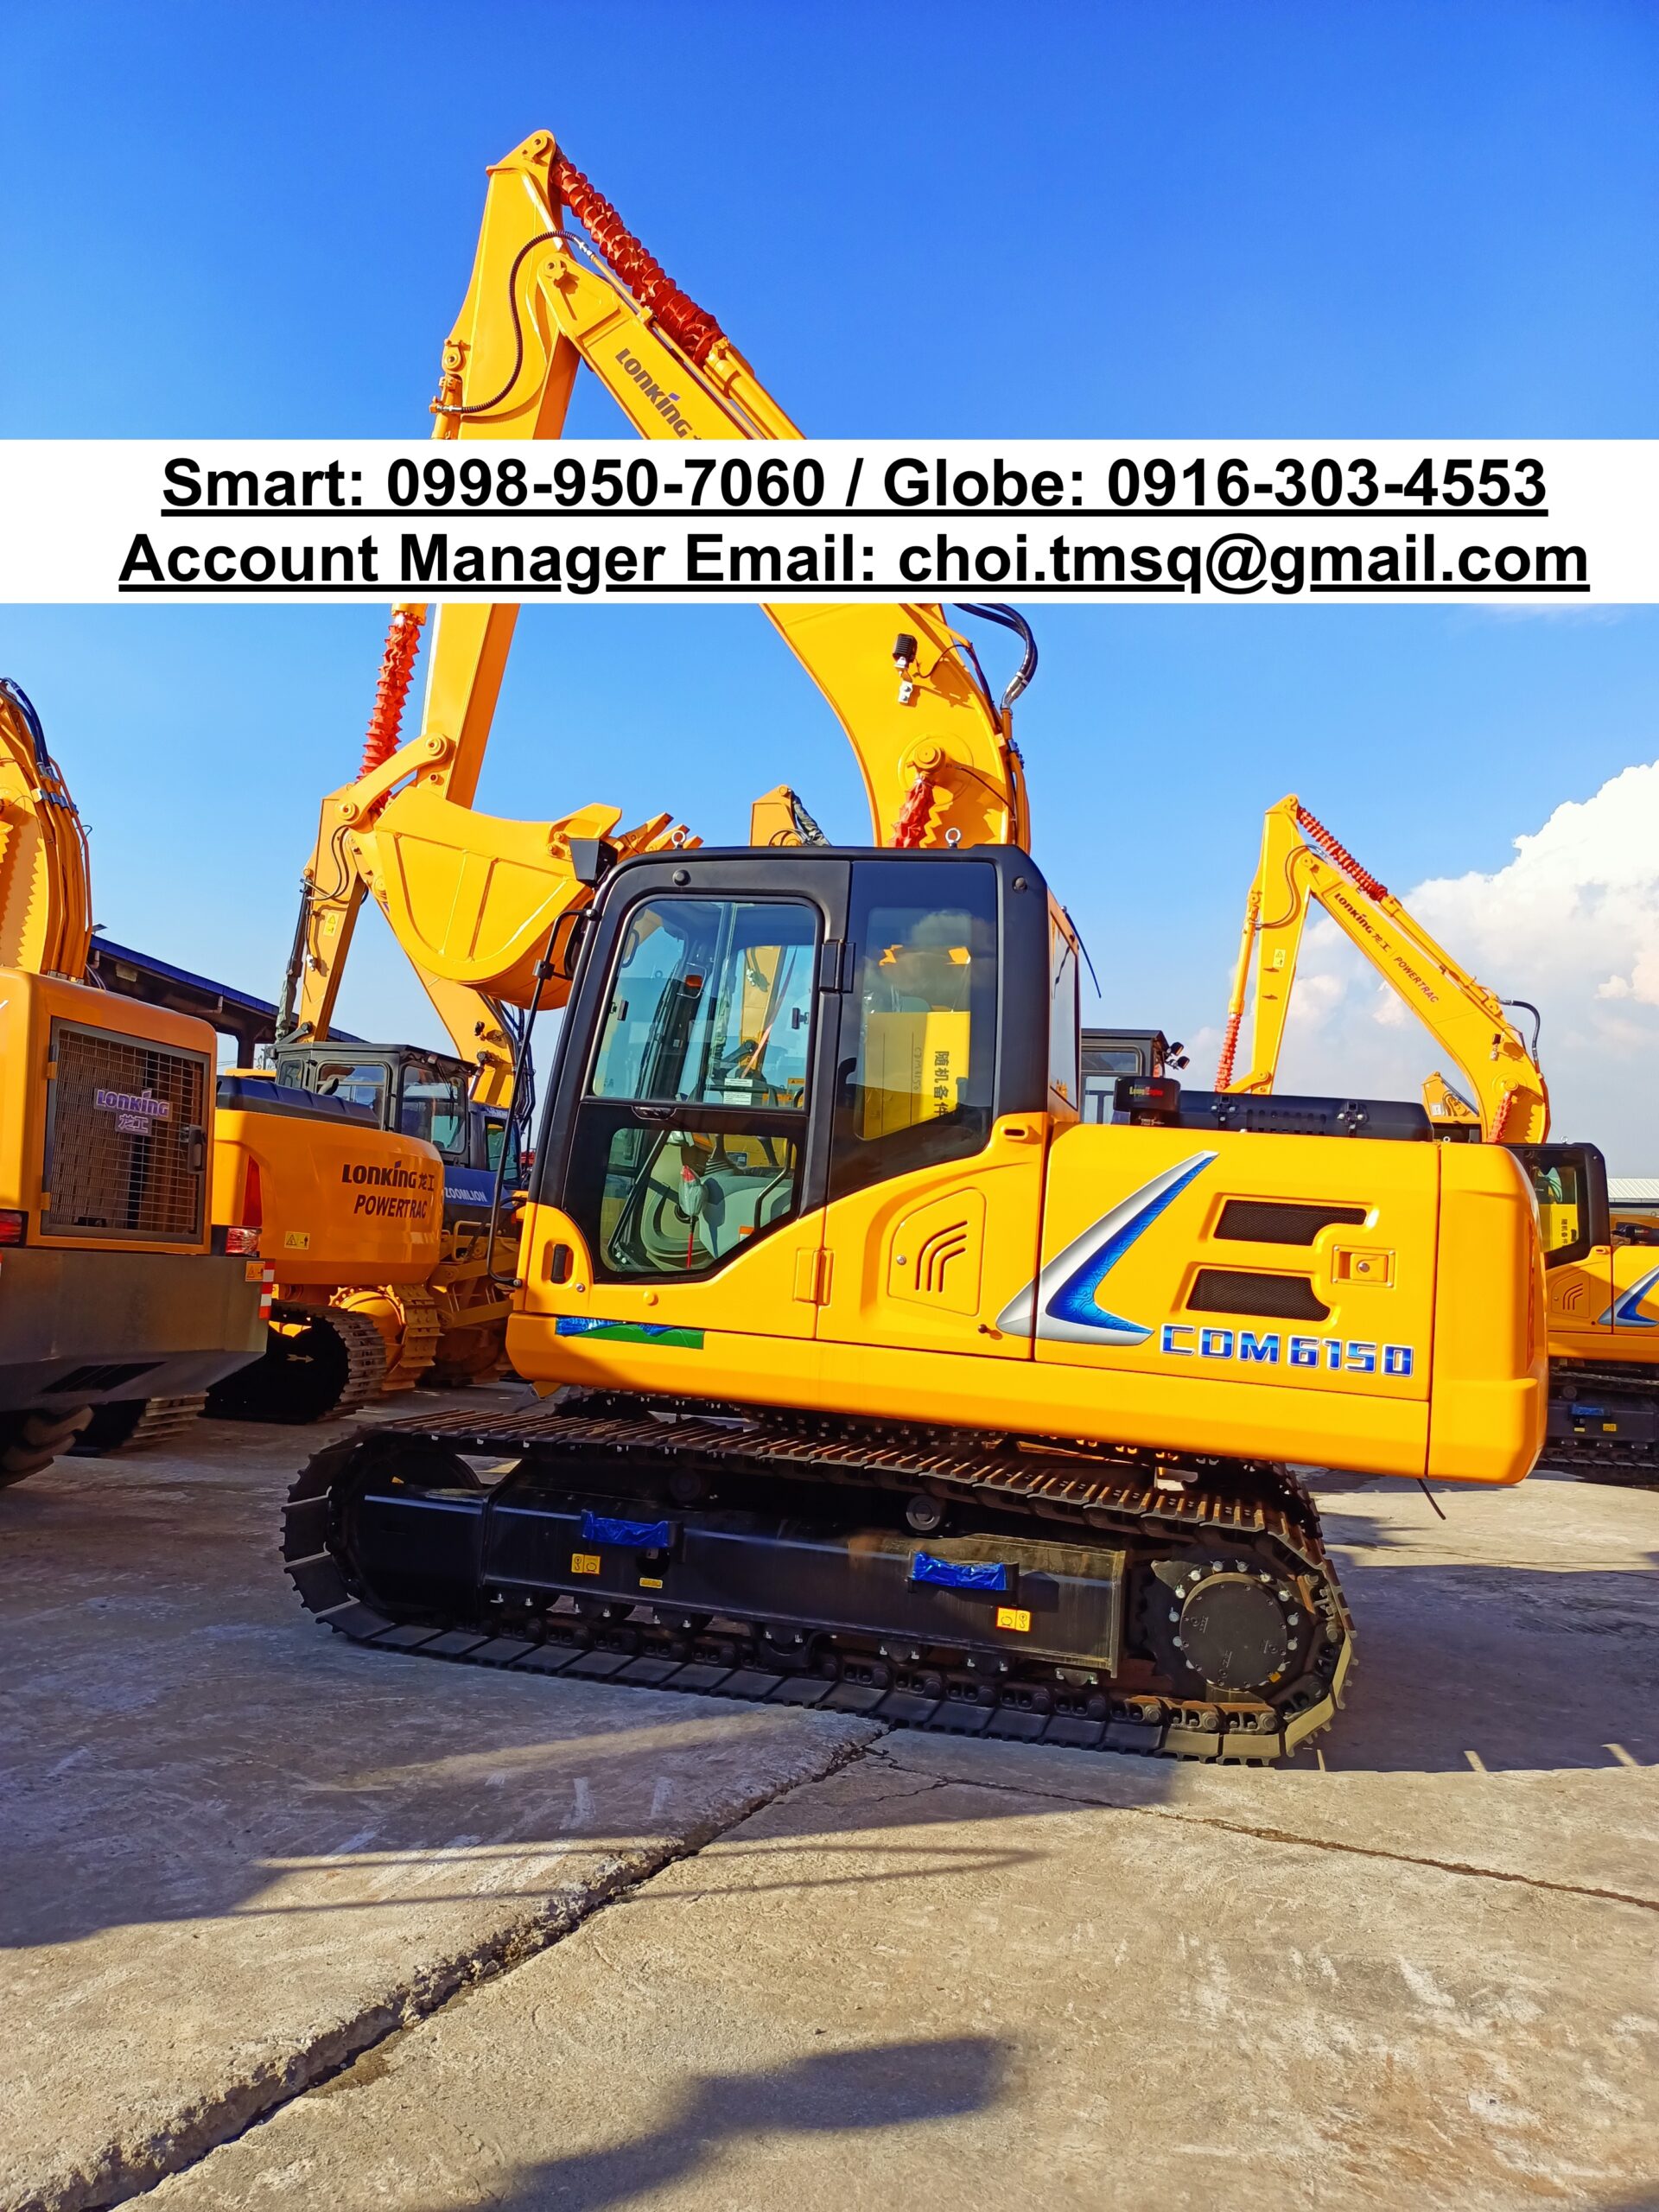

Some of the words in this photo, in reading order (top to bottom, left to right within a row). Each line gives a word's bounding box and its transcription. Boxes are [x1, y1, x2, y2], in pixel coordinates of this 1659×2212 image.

[1393, 957, 1440, 1003] POWERTRAC
[933, 1051, 950, 1116] 随机备件
[353, 1194, 428, 1219] POWERTRAC
[444, 1186, 487, 1203] ZOOMLION
[1160, 1323, 1414, 1378] CDM6150
